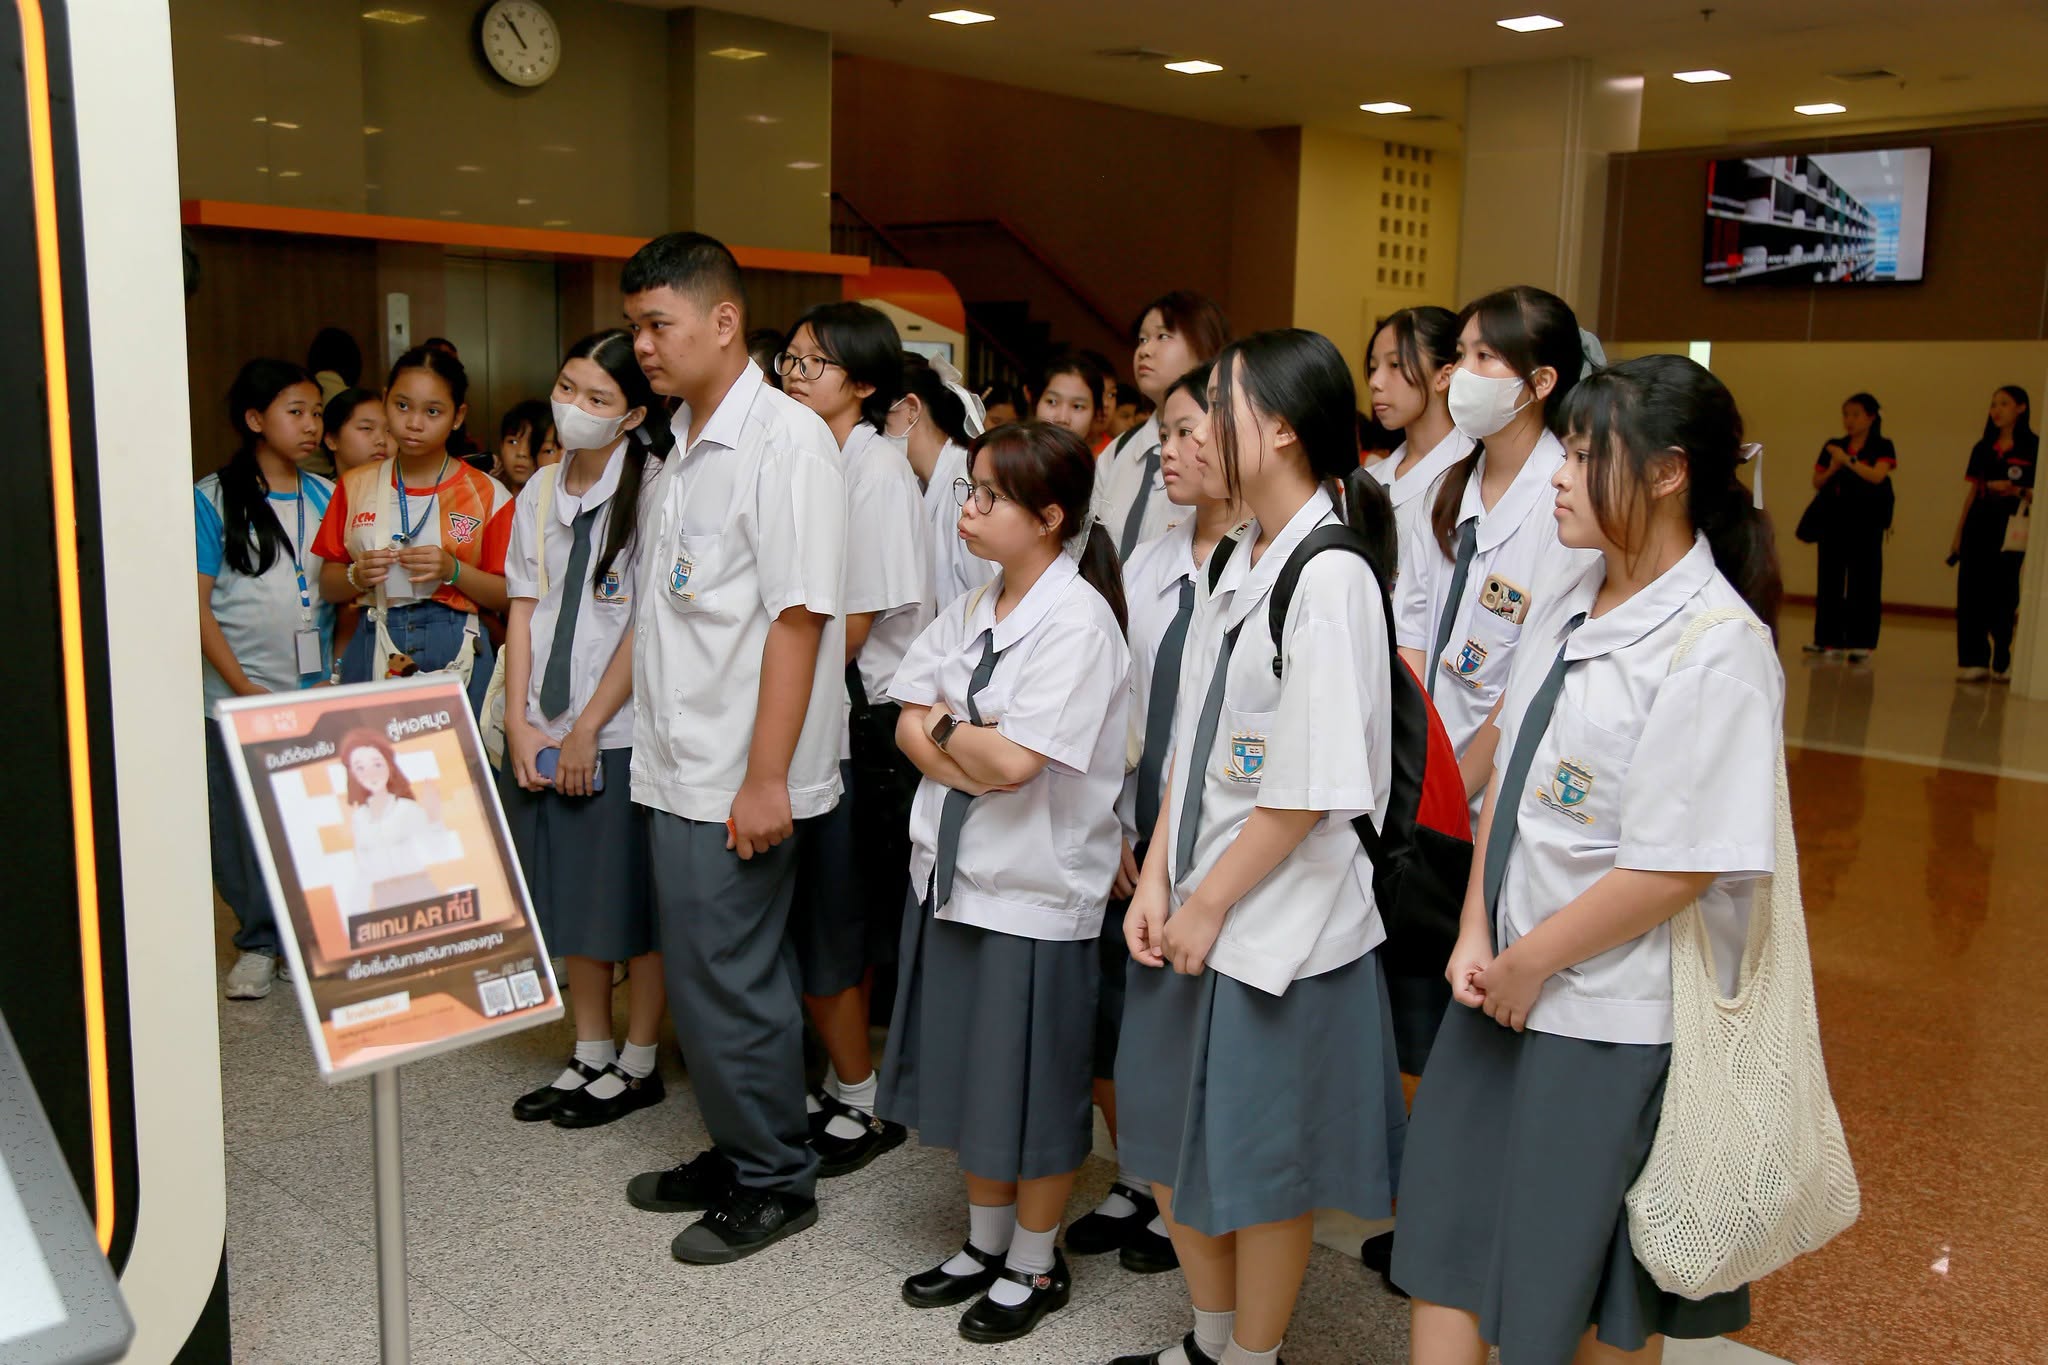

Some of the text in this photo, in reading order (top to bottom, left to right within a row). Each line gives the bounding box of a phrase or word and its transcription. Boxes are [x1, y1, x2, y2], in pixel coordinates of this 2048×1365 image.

[386, 710, 450, 742] สู่หอสมุด
[357, 890, 473, 943] สแกน AR ที่นี่
